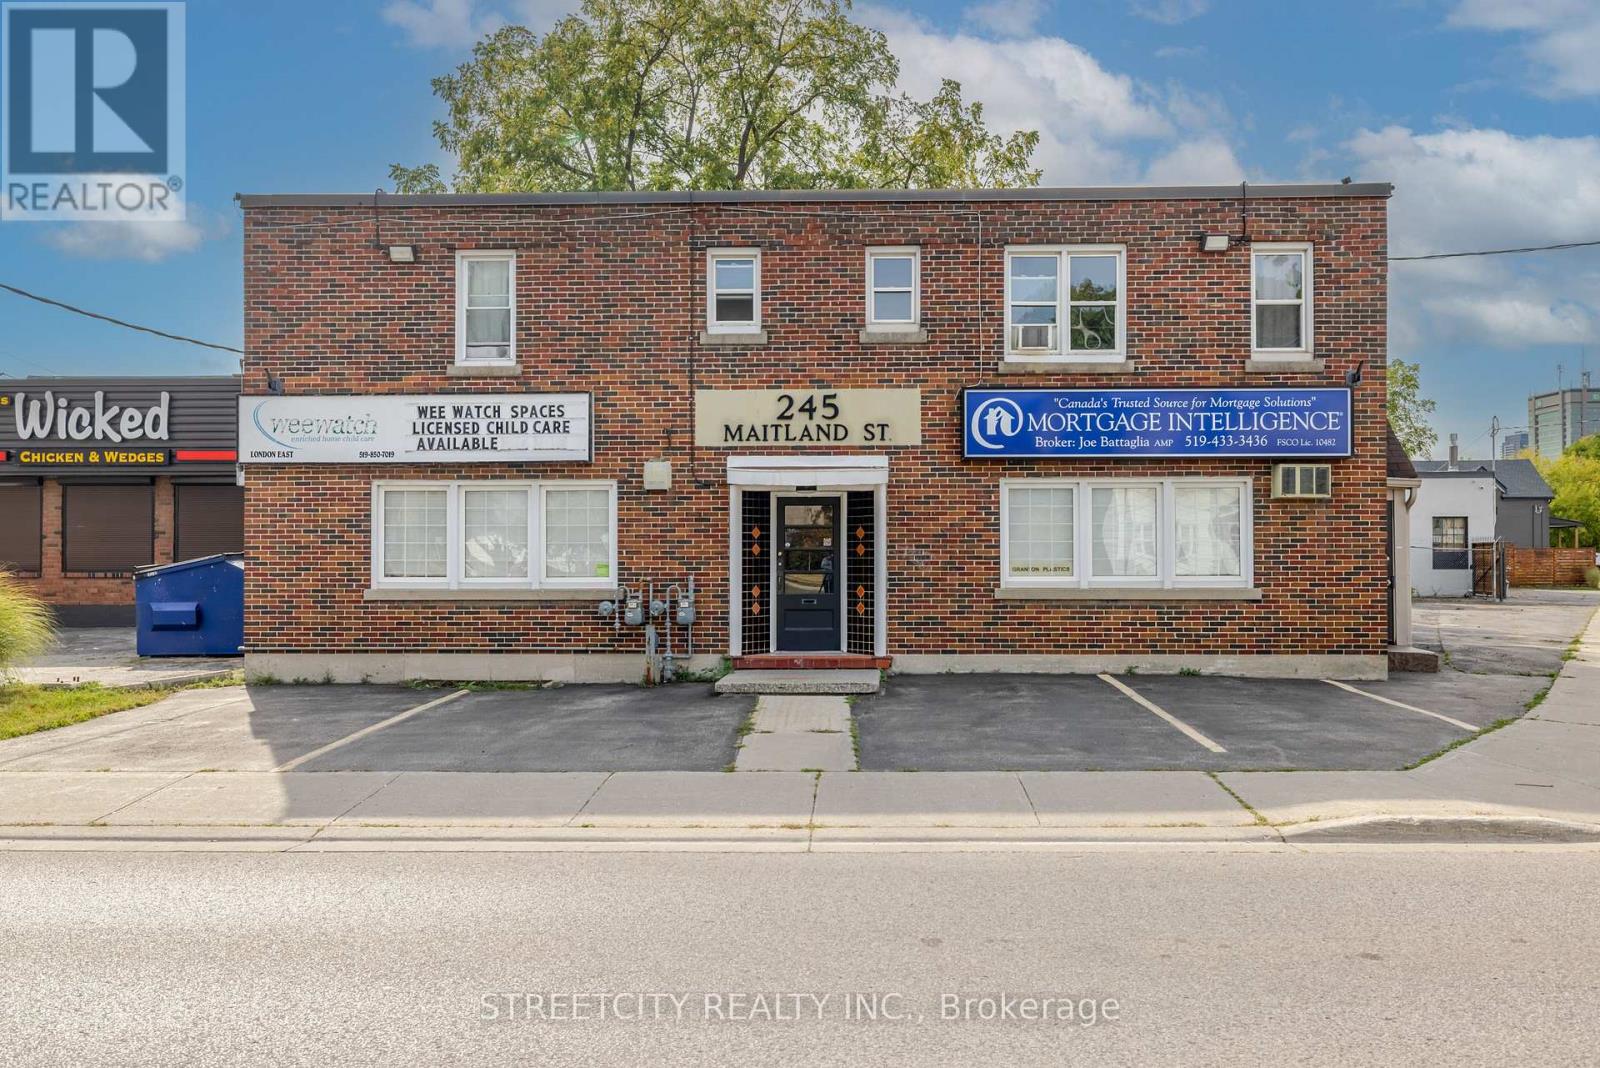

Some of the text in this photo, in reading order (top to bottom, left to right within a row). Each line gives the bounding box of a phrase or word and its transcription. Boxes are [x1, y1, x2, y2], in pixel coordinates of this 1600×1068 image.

[776, 393, 840, 421] 245
[1053, 396, 1317, 410] "Canada's Trusted Source for Mortgage Solutions"
[14, 390, 170, 443] Wicked
[417, 404, 565, 419] WEE WATCH SPACES
[270, 413, 378, 435] weewatch
[412, 420, 570, 435] LICENSED CHILD CARE
[1027, 412, 1162, 432] MORTGAGE
[723, 423, 892, 442] MAITLAND ST.
[416, 437, 498, 451] AVAILABLE
[1034, 436, 1174, 450] Broker: Joe Battaglia AMP
[1185, 435, 1336, 448] 519-433-3436 FSCO Lic. 10482
[89, 451, 100, 463] &
[250, 451, 276, 459] LONDON
